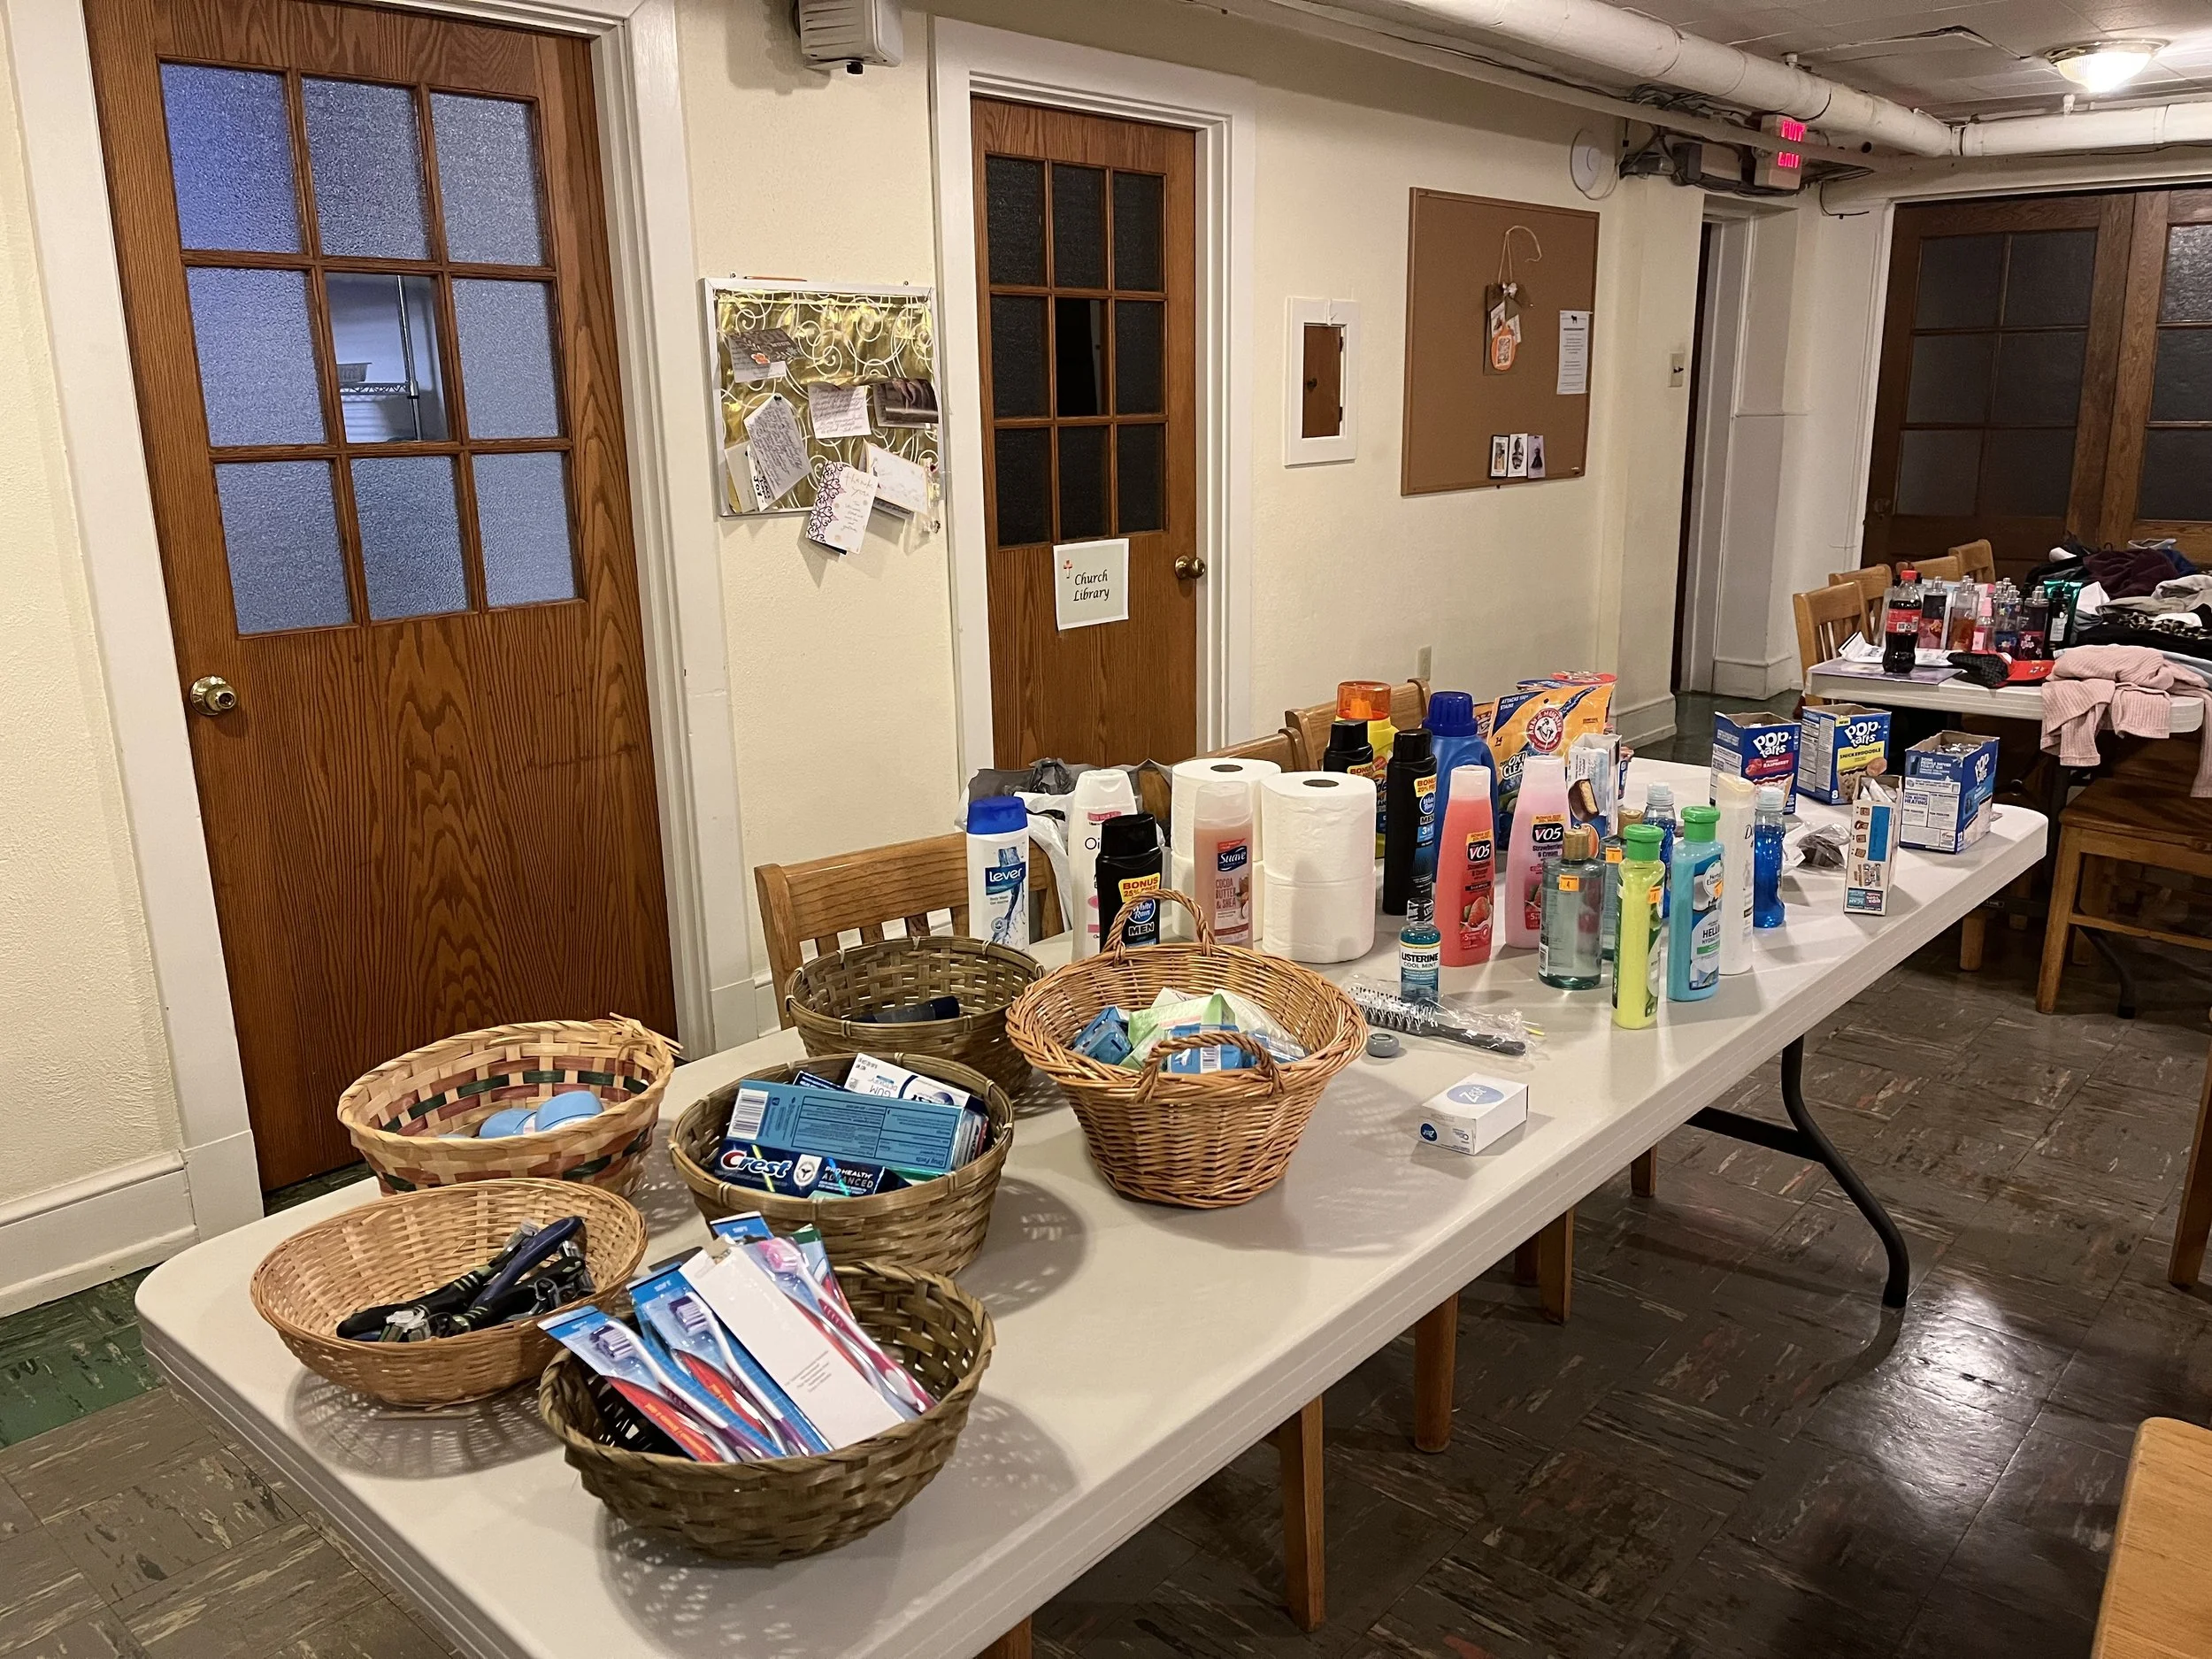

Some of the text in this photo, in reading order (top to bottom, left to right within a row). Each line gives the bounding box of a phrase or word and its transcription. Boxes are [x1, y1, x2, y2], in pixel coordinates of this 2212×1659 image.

[1074, 569, 1108, 585] Church
[1073, 588, 1110, 602] Library
[1508, 753, 1526, 767] OXI
[1503, 764, 1524, 779] CLEA
[1832, 789, 1839, 800] 8
[1085, 837, 1100, 850] Oi
[1219, 850, 1247, 864] Suave
[1469, 843, 1491, 860] VO5
[1122, 877, 1159, 890] BONUS
[1215, 878, 1234, 889] COCOA
[1216, 897, 1237, 910] & SHEA
[1128, 921, 1155, 936] MEN
[1402, 951, 1439, 963] LISTERINE
[869, 1085, 891, 1099] GUM
[720, 1150, 793, 1178] Crest
[930, 1157, 944, 1166] Drug
